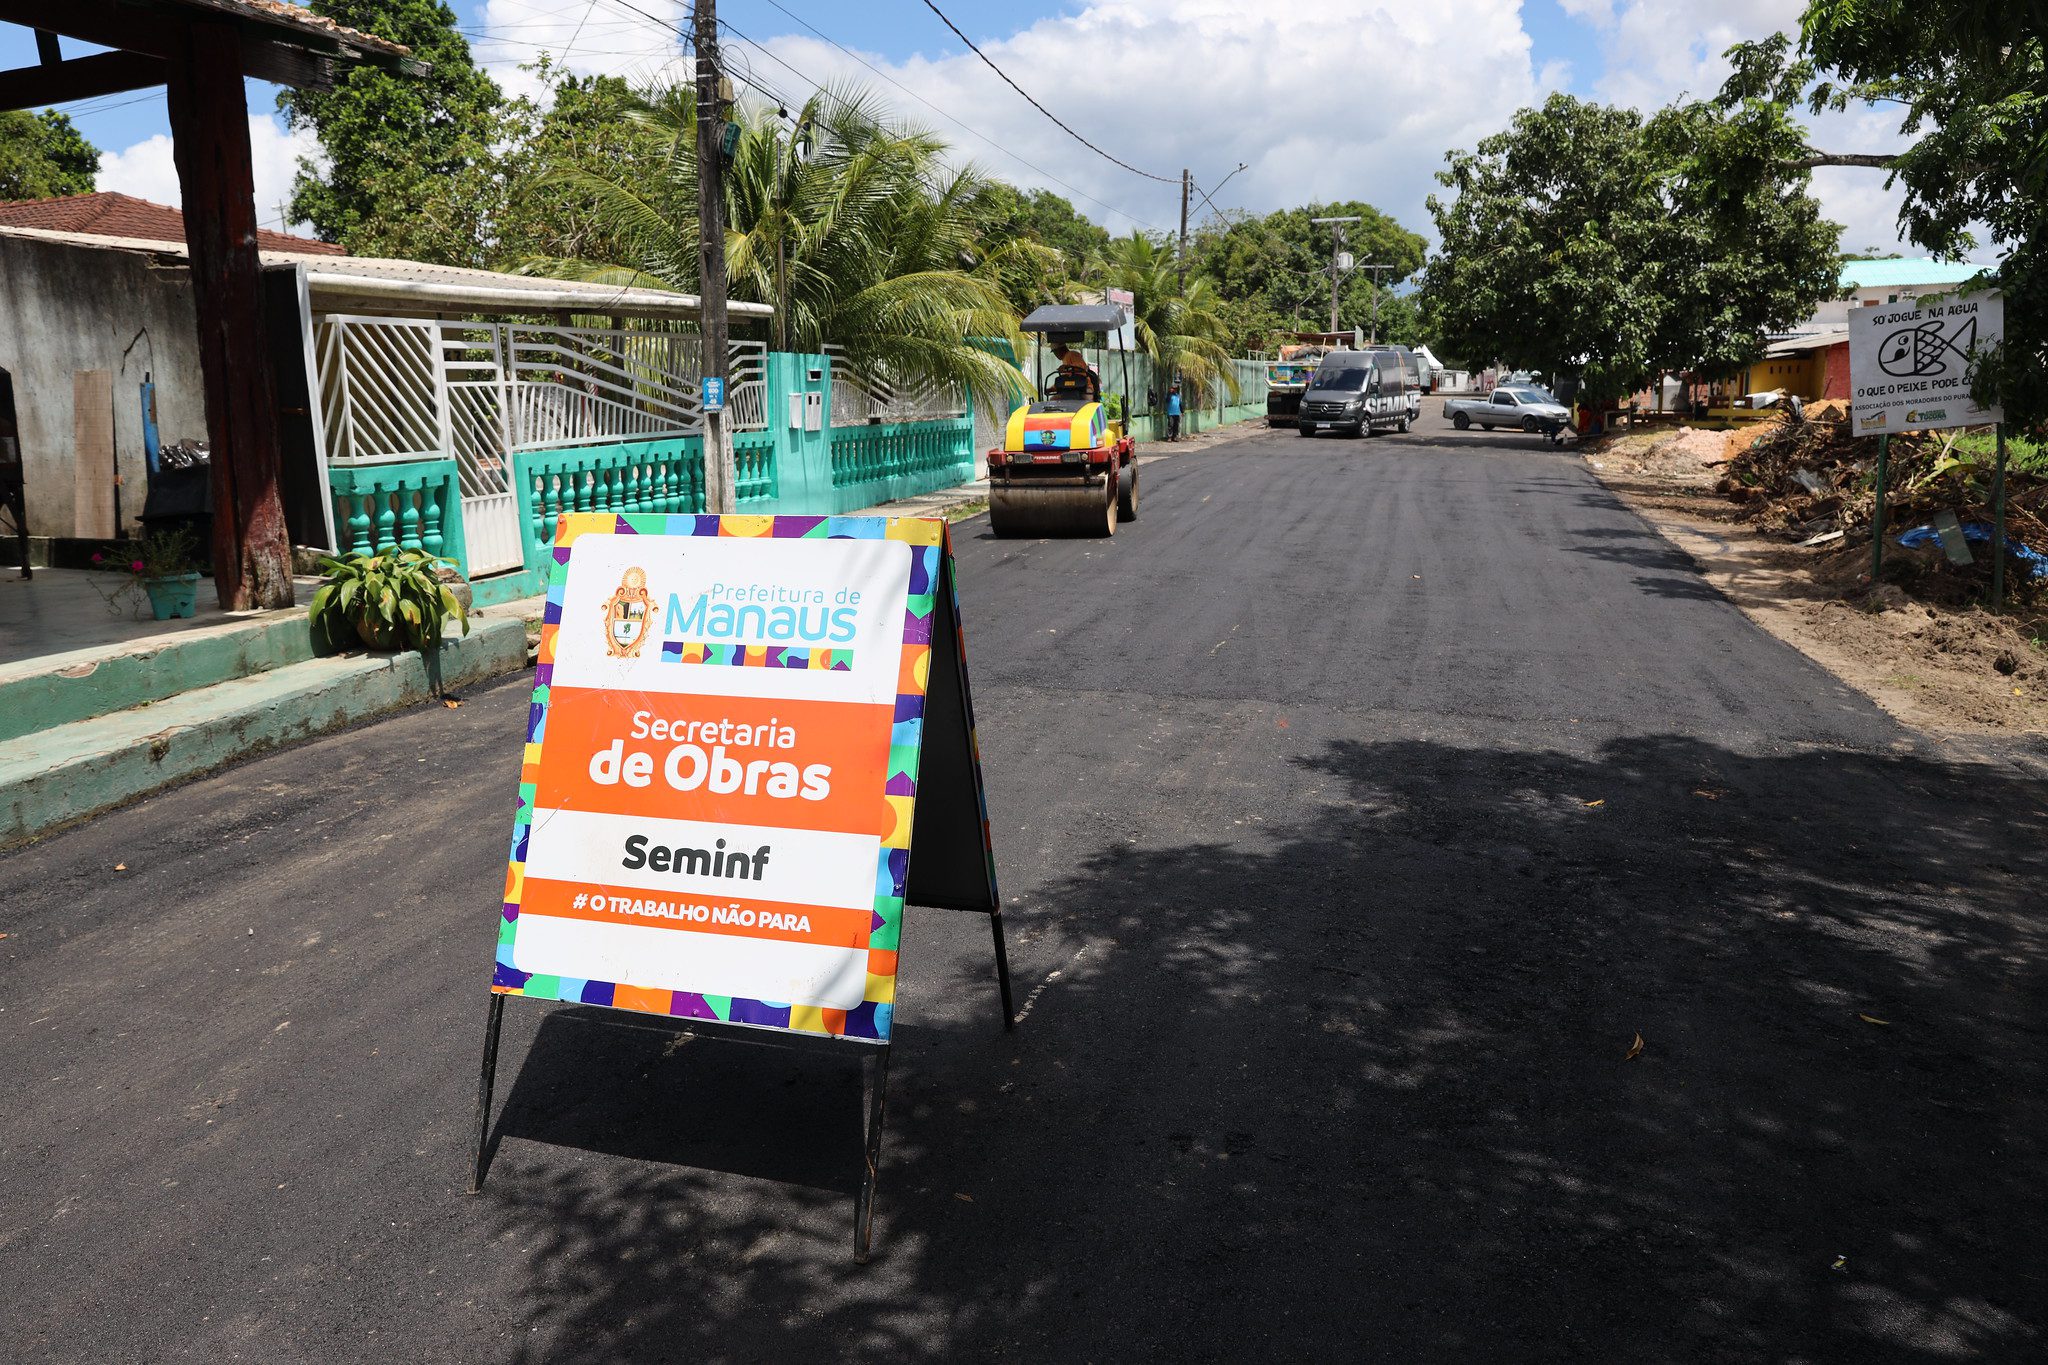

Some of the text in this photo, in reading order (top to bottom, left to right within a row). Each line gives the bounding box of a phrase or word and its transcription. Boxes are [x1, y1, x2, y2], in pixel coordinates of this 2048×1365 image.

[1888, 310, 1922, 324] JOGUE
[1928, 307, 1944, 319] NA
[1854, 401, 1892, 411] ASSOCIAÇÃO
[1906, 396, 1942, 405] MORADORES
[1857, 388, 1865, 397] O
[1867, 386, 1886, 397] QUE
[1888, 384, 1895, 394] O
[1897, 381, 1928, 393] PEIXE
[1932, 377, 1959, 389] PODE
[712, 583, 861, 604] Prefeitura de
[664, 592, 858, 643] Manaus
[630, 710, 796, 749] Secretaria
[588, 738, 832, 801] de Obras
[622, 834, 771, 881] Seminf
[590, 895, 606, 911] O
[607, 896, 709, 922] TRABALHO
[712, 903, 756, 927] NÃO
[758, 911, 811, 933] PARA
